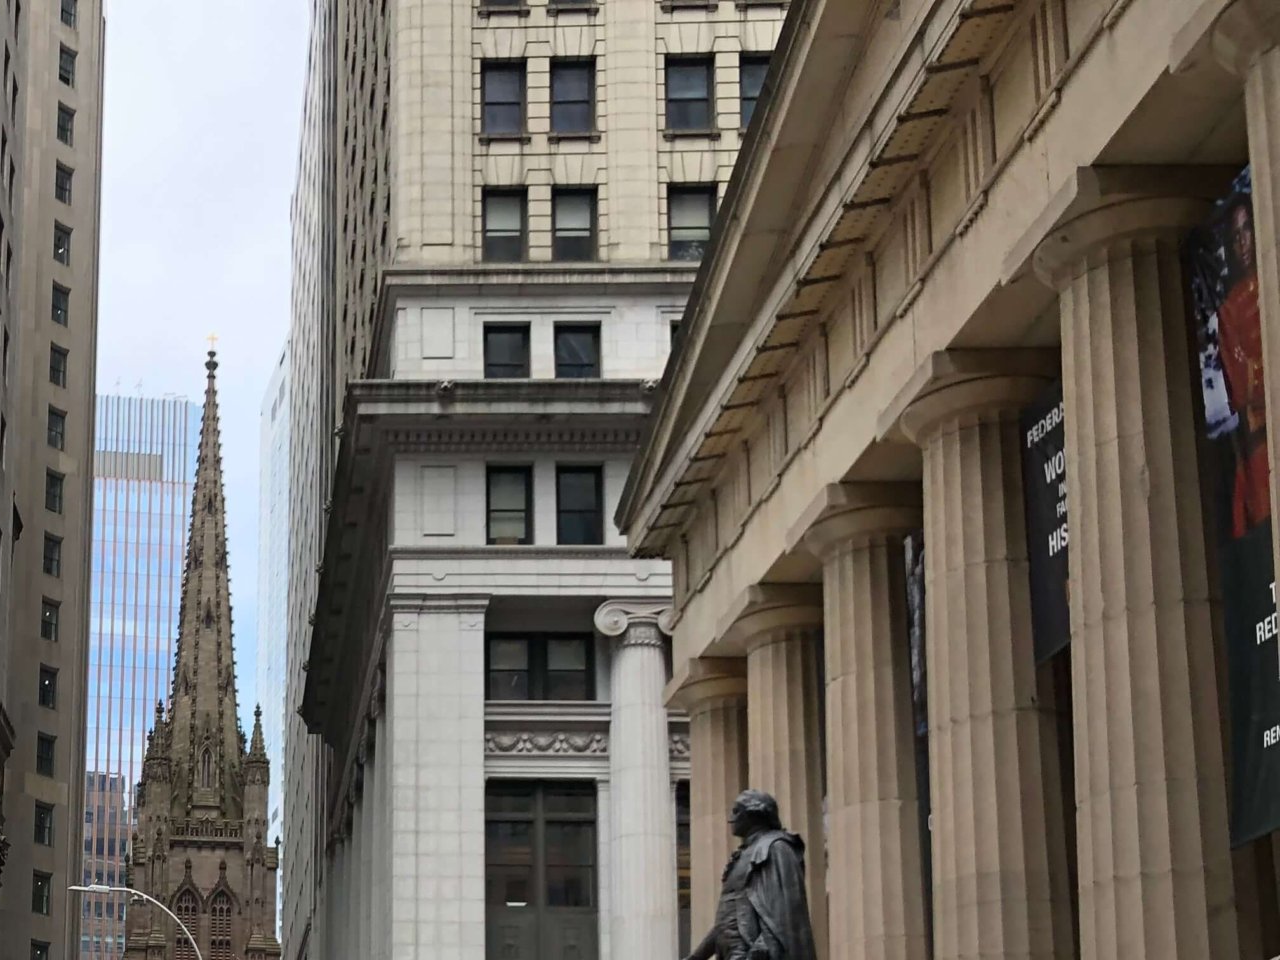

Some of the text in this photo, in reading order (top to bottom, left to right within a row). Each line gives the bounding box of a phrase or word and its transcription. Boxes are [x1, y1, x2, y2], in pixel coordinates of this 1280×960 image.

[1027, 402, 1064, 448] FEDERA
[1044, 449, 1066, 484] WO
[1056, 499, 1068, 518] FA
[1048, 523, 1068, 557] HIS
[1255, 612, 1279, 645] RED
